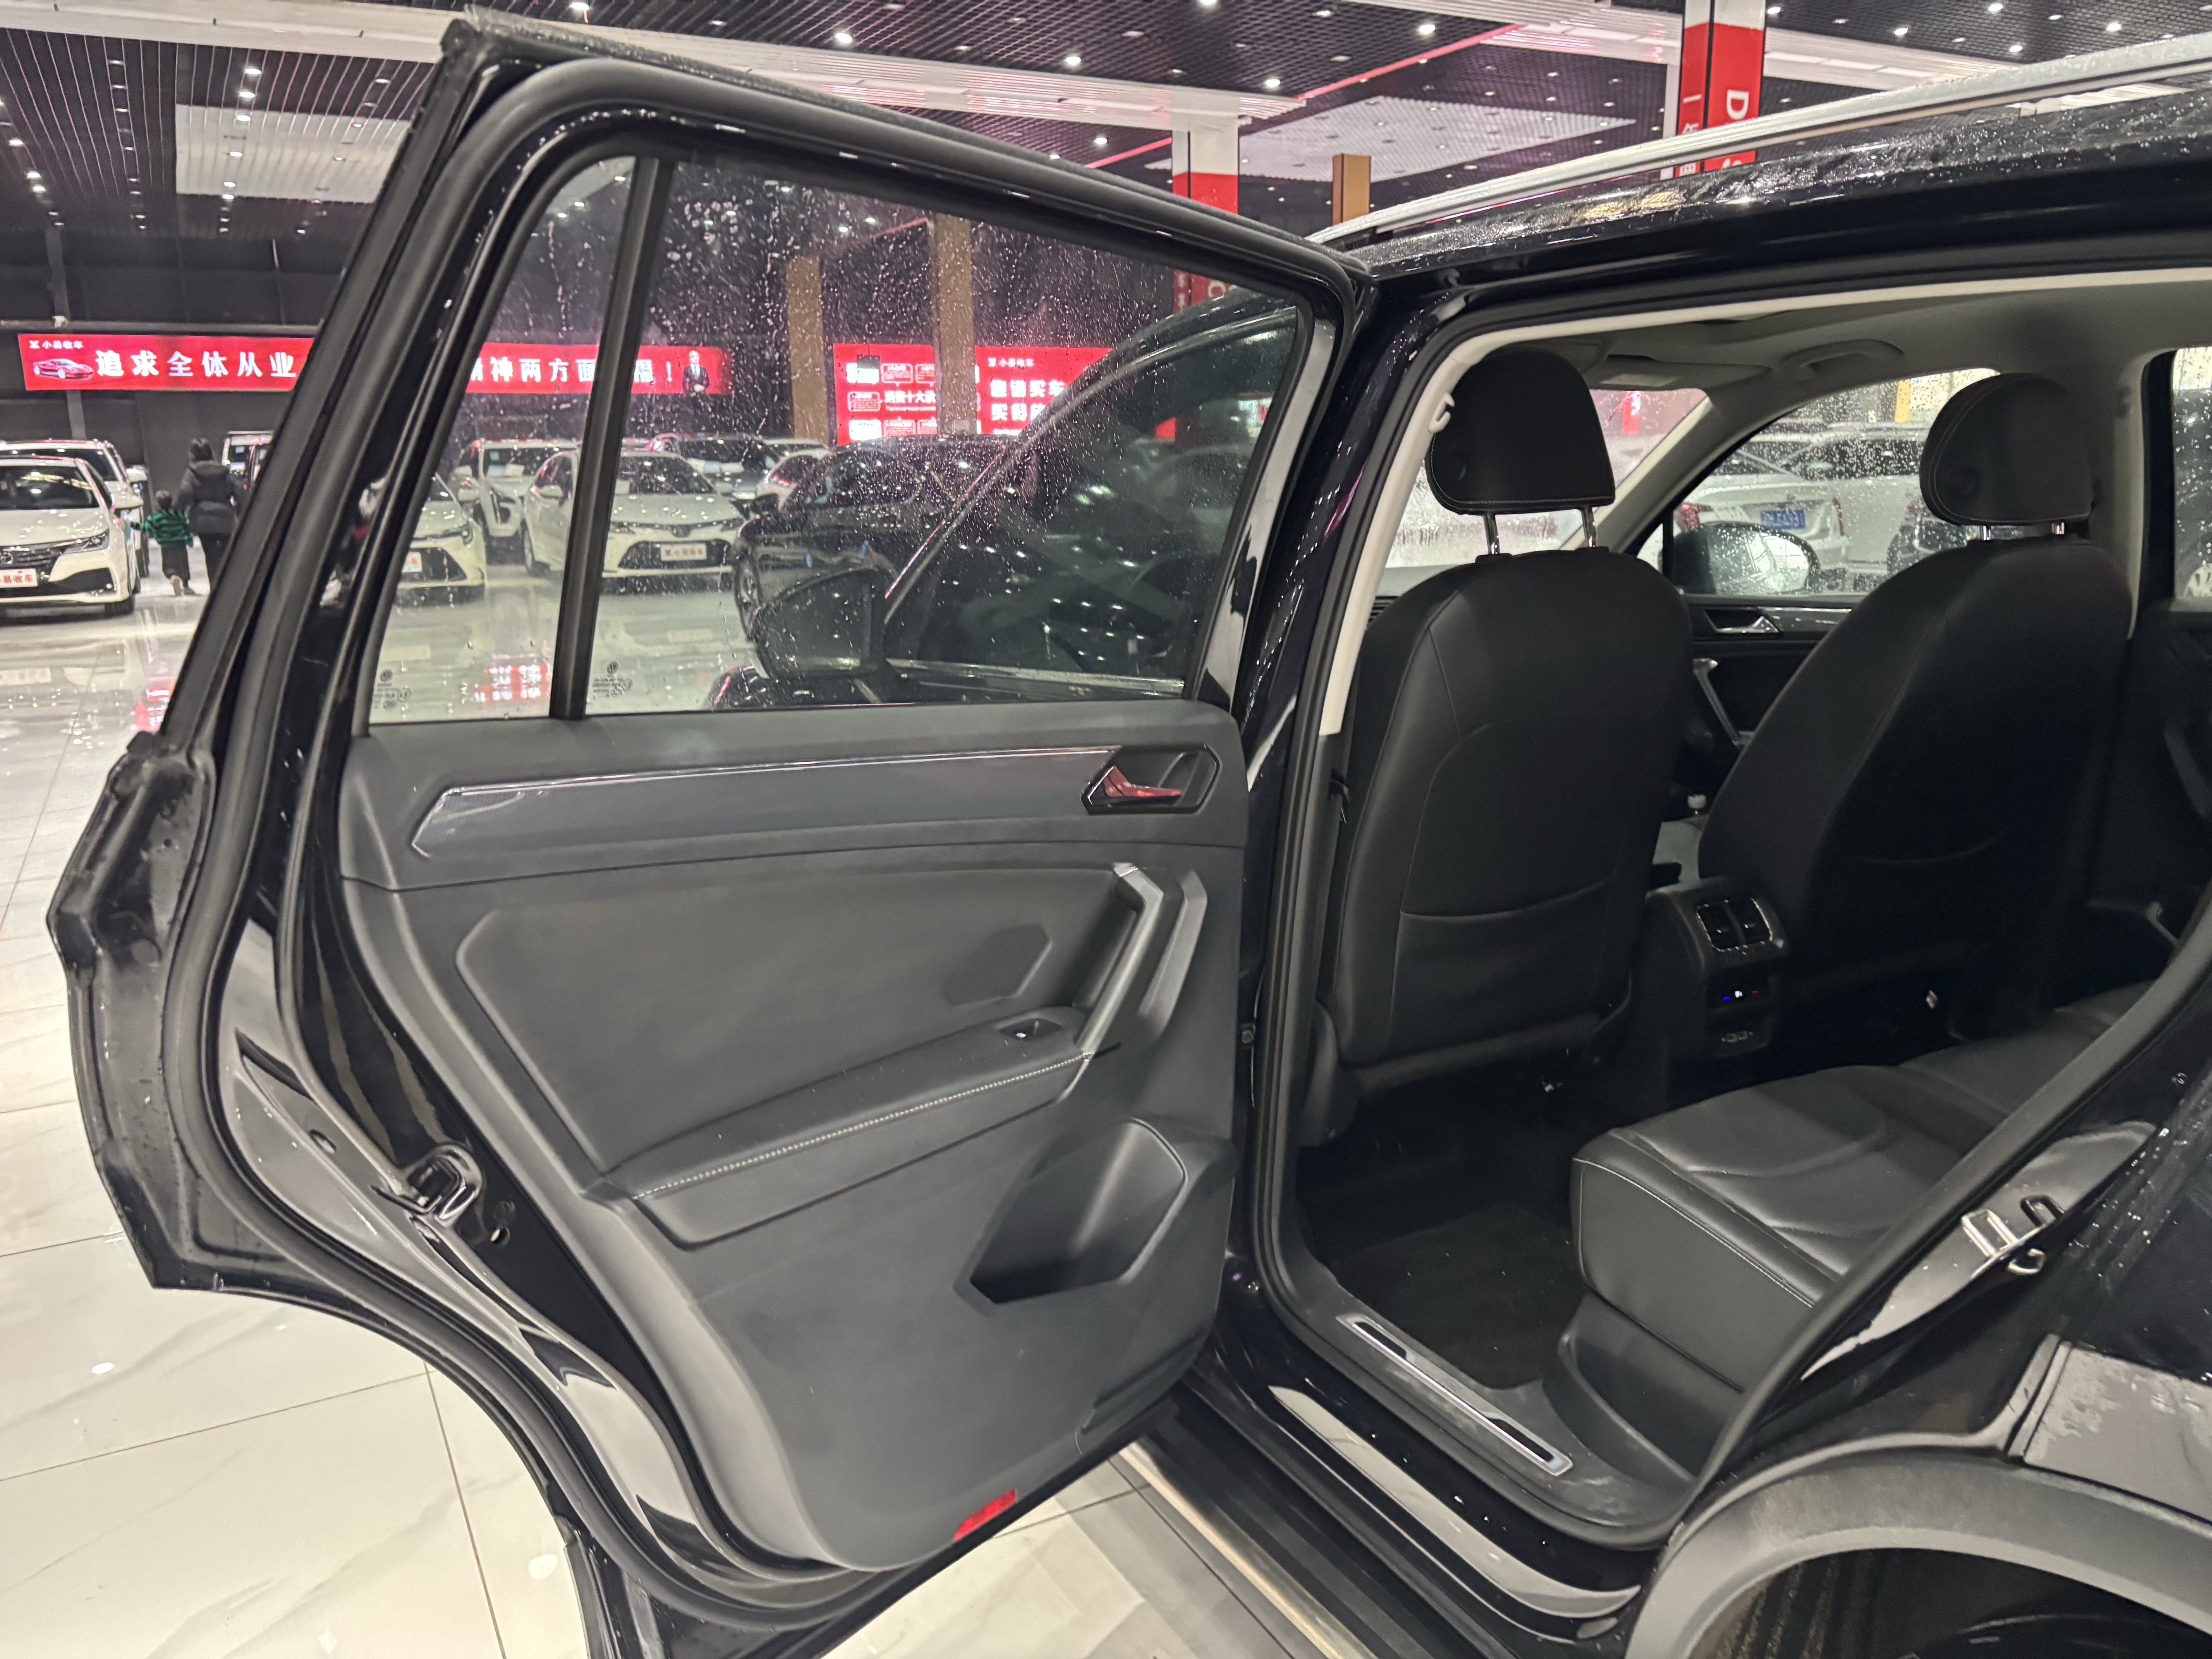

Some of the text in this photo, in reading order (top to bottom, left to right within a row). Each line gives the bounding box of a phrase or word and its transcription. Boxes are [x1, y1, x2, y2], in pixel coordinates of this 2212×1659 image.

[95, 350, 296, 377] 追求全体从业
